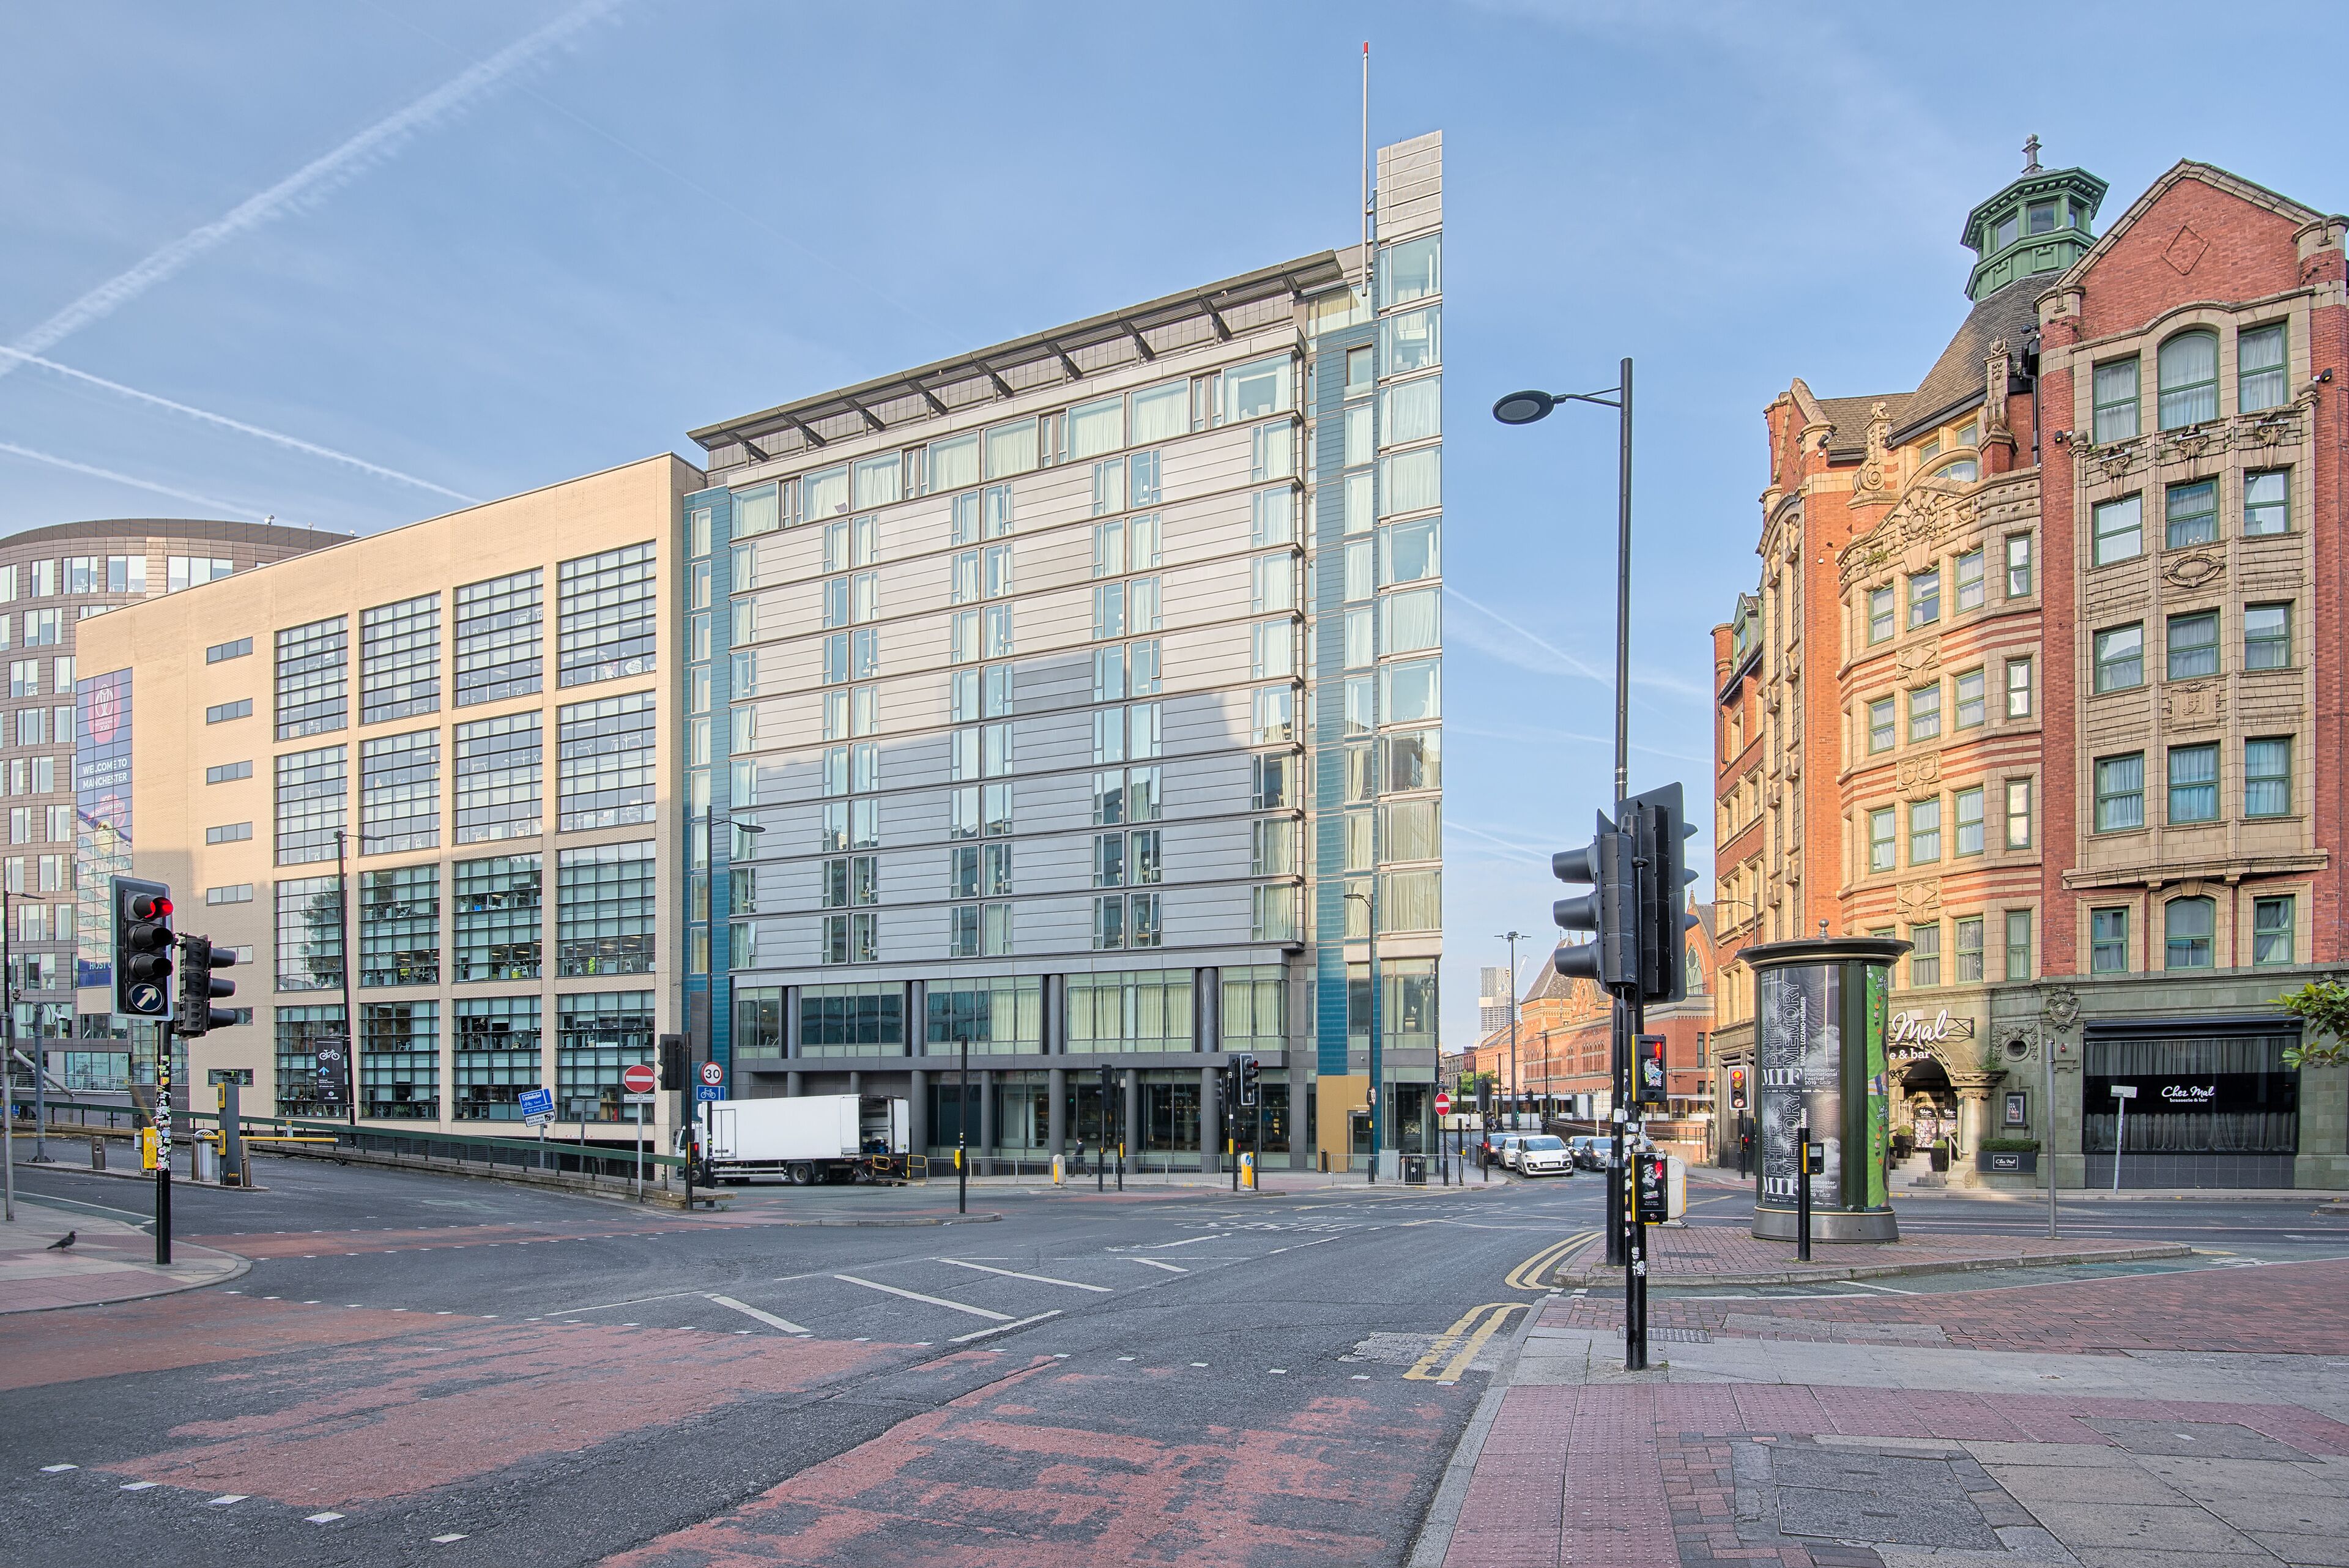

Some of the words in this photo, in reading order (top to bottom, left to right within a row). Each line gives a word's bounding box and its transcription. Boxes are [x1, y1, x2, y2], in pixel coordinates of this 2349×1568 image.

[83, 760, 116, 775] WELCOME
[117, 758, 127, 768] TO
[83, 772, 127, 789] MANCHESTER
[1770, 998, 1782, 1067] PHERIC
[1783, 981, 1799, 1067] MEMORY
[1892, 1009, 1949, 1046] Mal
[1899, 1050, 1908, 1060] &
[1910, 1048, 1931, 1059] bar
[705, 1069, 720, 1079] 30
[1762, 1068, 1803, 1086] MIF
[2161, 1085, 2189, 1097] Chez
[2190, 1086, 2214, 1098] Mal
[1770, 1106, 1783, 1176] PHERIC
[1783, 1094, 1800, 1176] MEMORY
